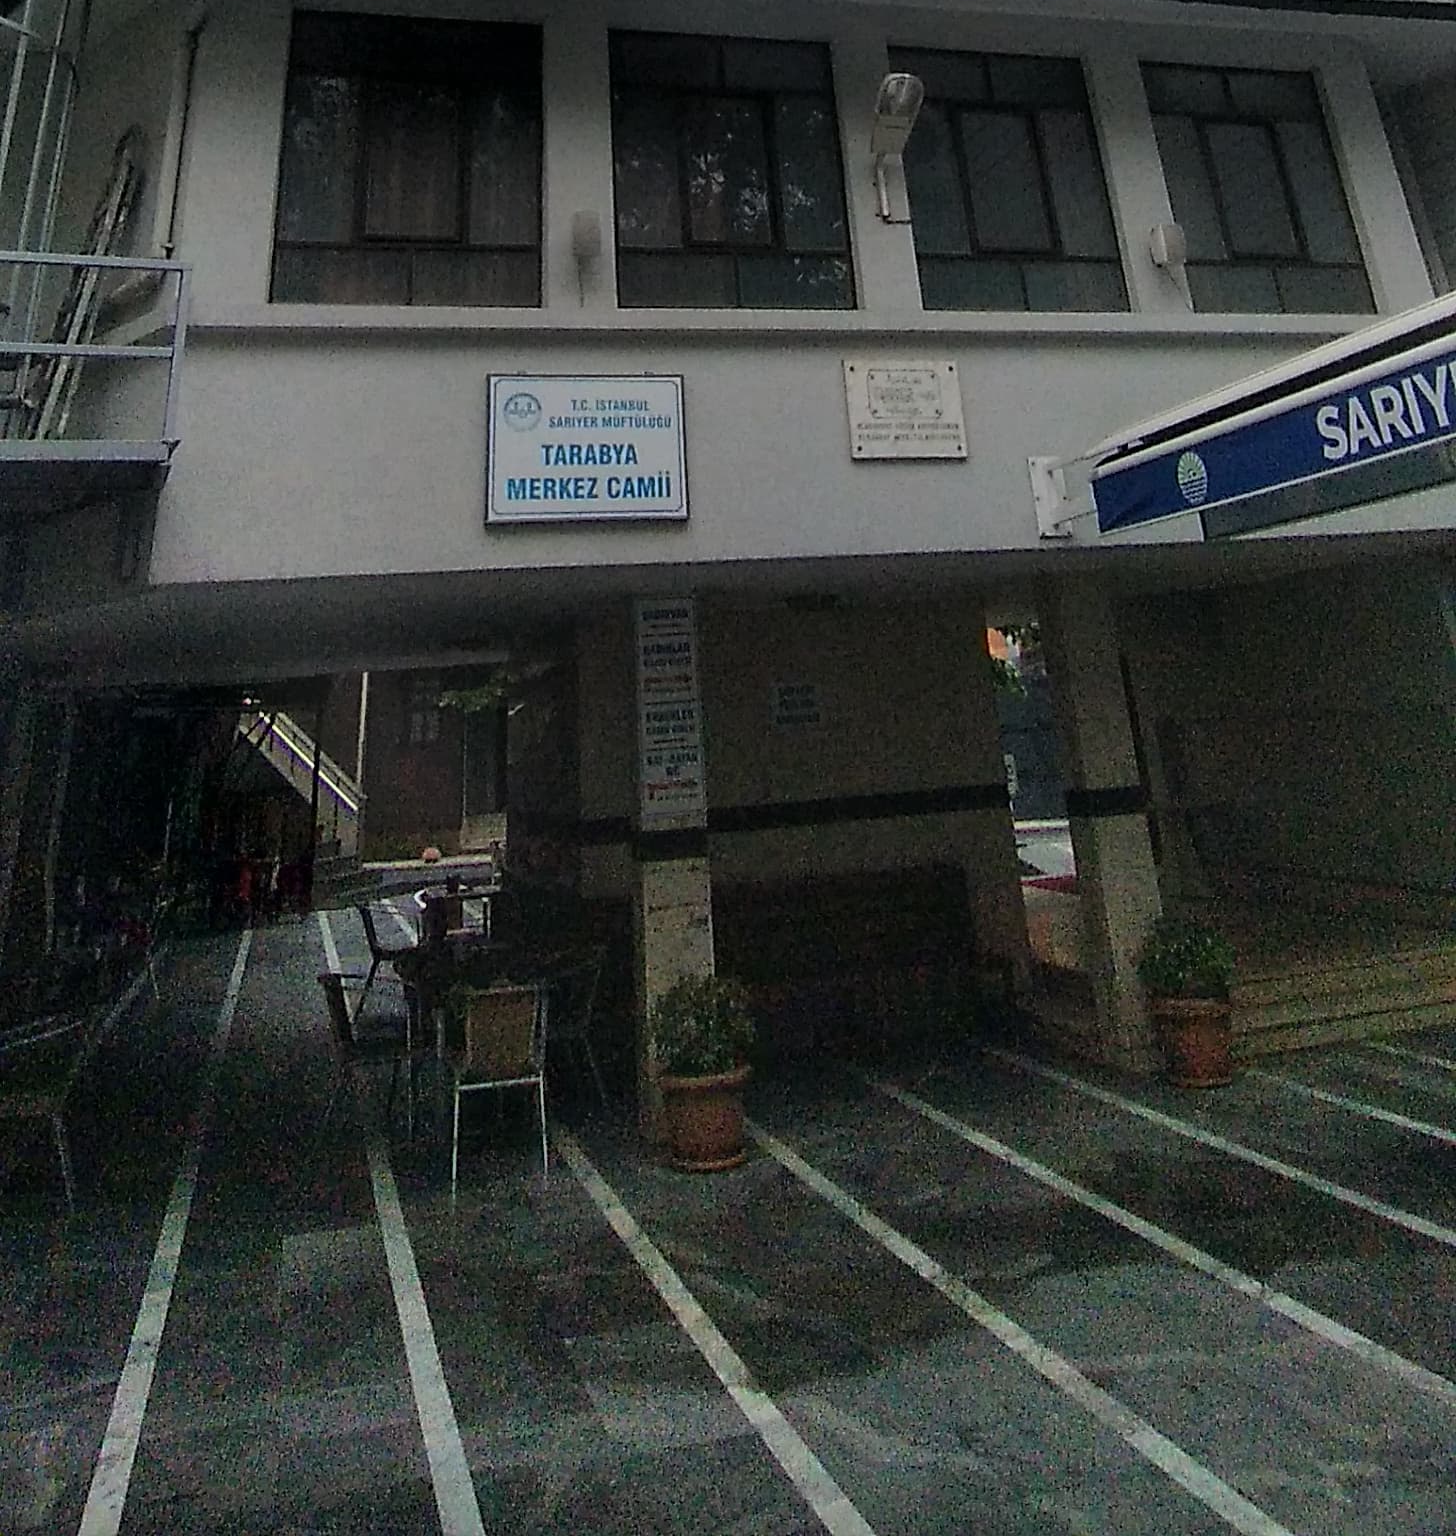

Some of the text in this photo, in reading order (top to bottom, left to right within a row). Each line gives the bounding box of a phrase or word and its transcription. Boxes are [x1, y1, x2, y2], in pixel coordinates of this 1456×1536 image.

[571, 399, 591, 411] T.C.
[1316, 360, 1456, 460] SARIY
[548, 416, 599, 429] SARIYER
[541, 443, 639, 465] TARABYA
[507, 470, 672, 500] MERKEZ CAMİİ
